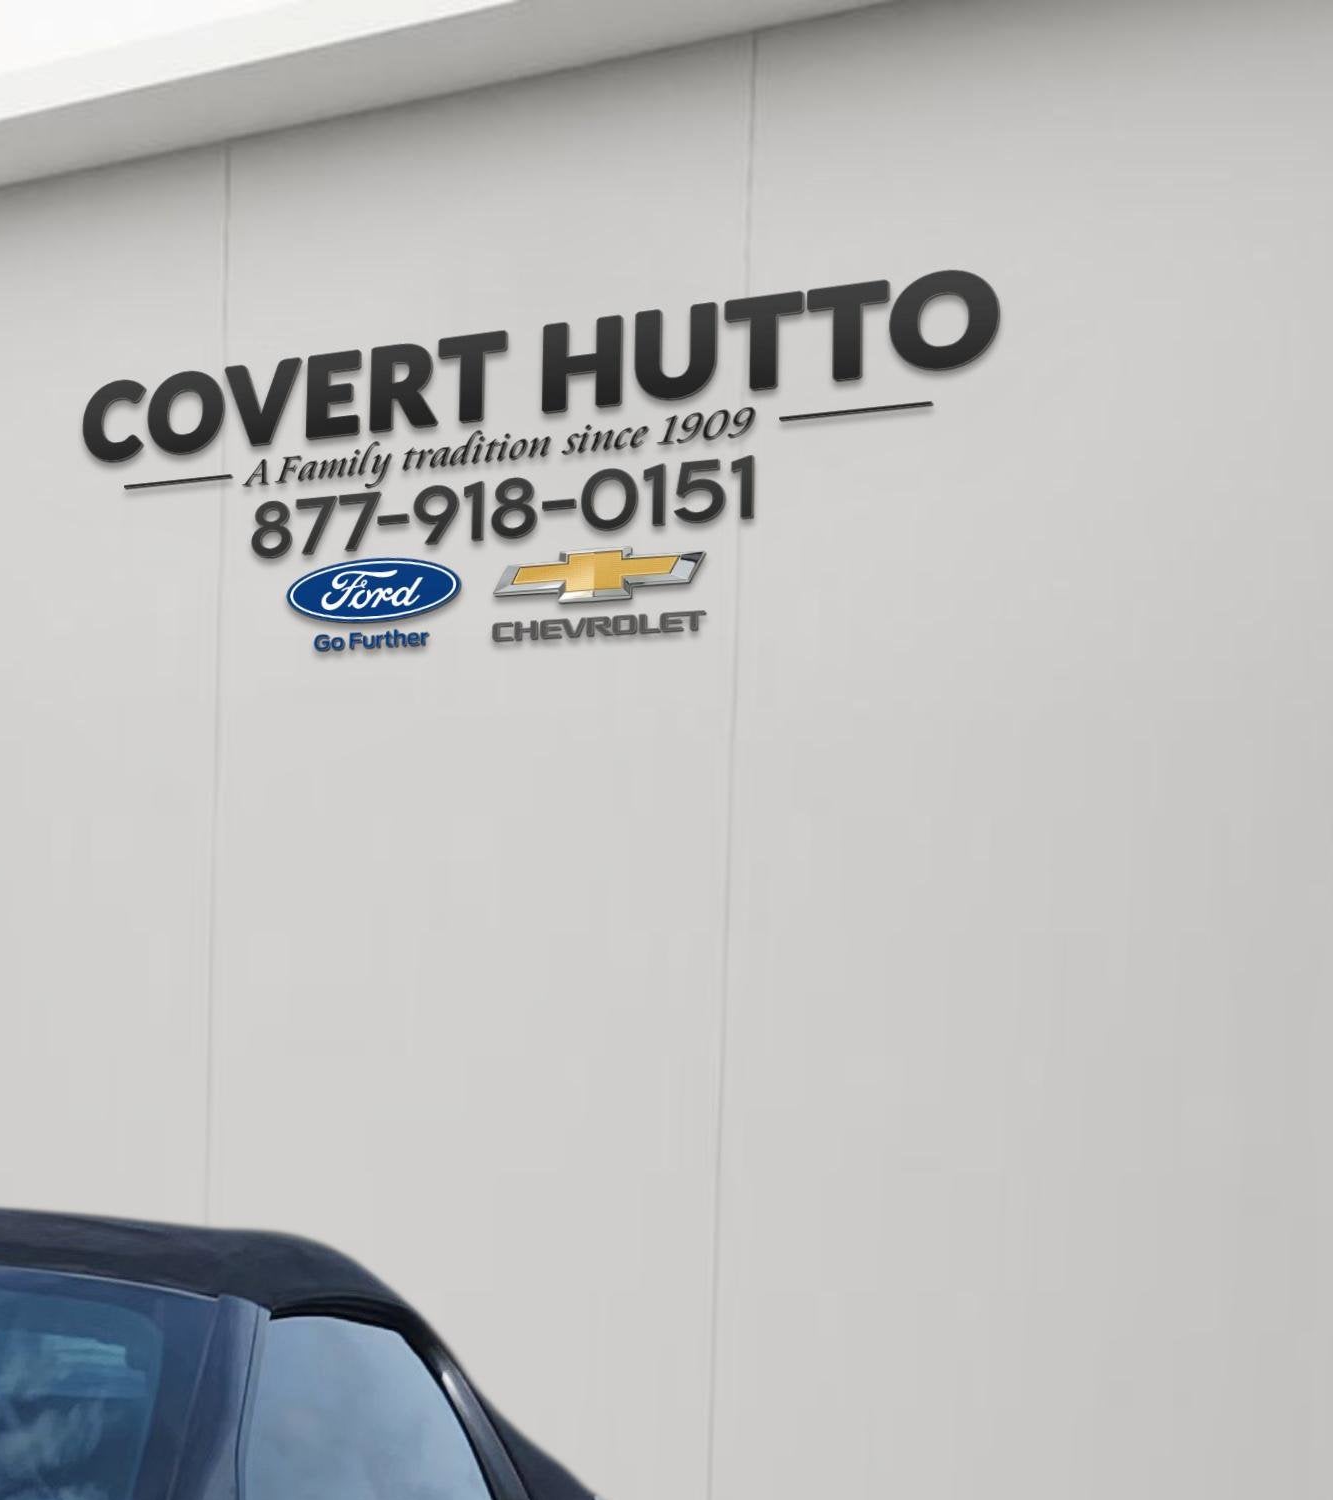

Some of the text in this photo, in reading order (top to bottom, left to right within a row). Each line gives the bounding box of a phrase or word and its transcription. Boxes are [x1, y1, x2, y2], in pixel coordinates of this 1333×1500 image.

[82, 269, 1002, 465] COVERT HUTTO
[242, 406, 757, 490] A Family tradition since 1909
[251, 454, 755, 560] 877-918-0151
[320, 568, 423, 611] Ford
[313, 628, 430, 653] Go Further
[491, 610, 707, 643] CHEVROLET
